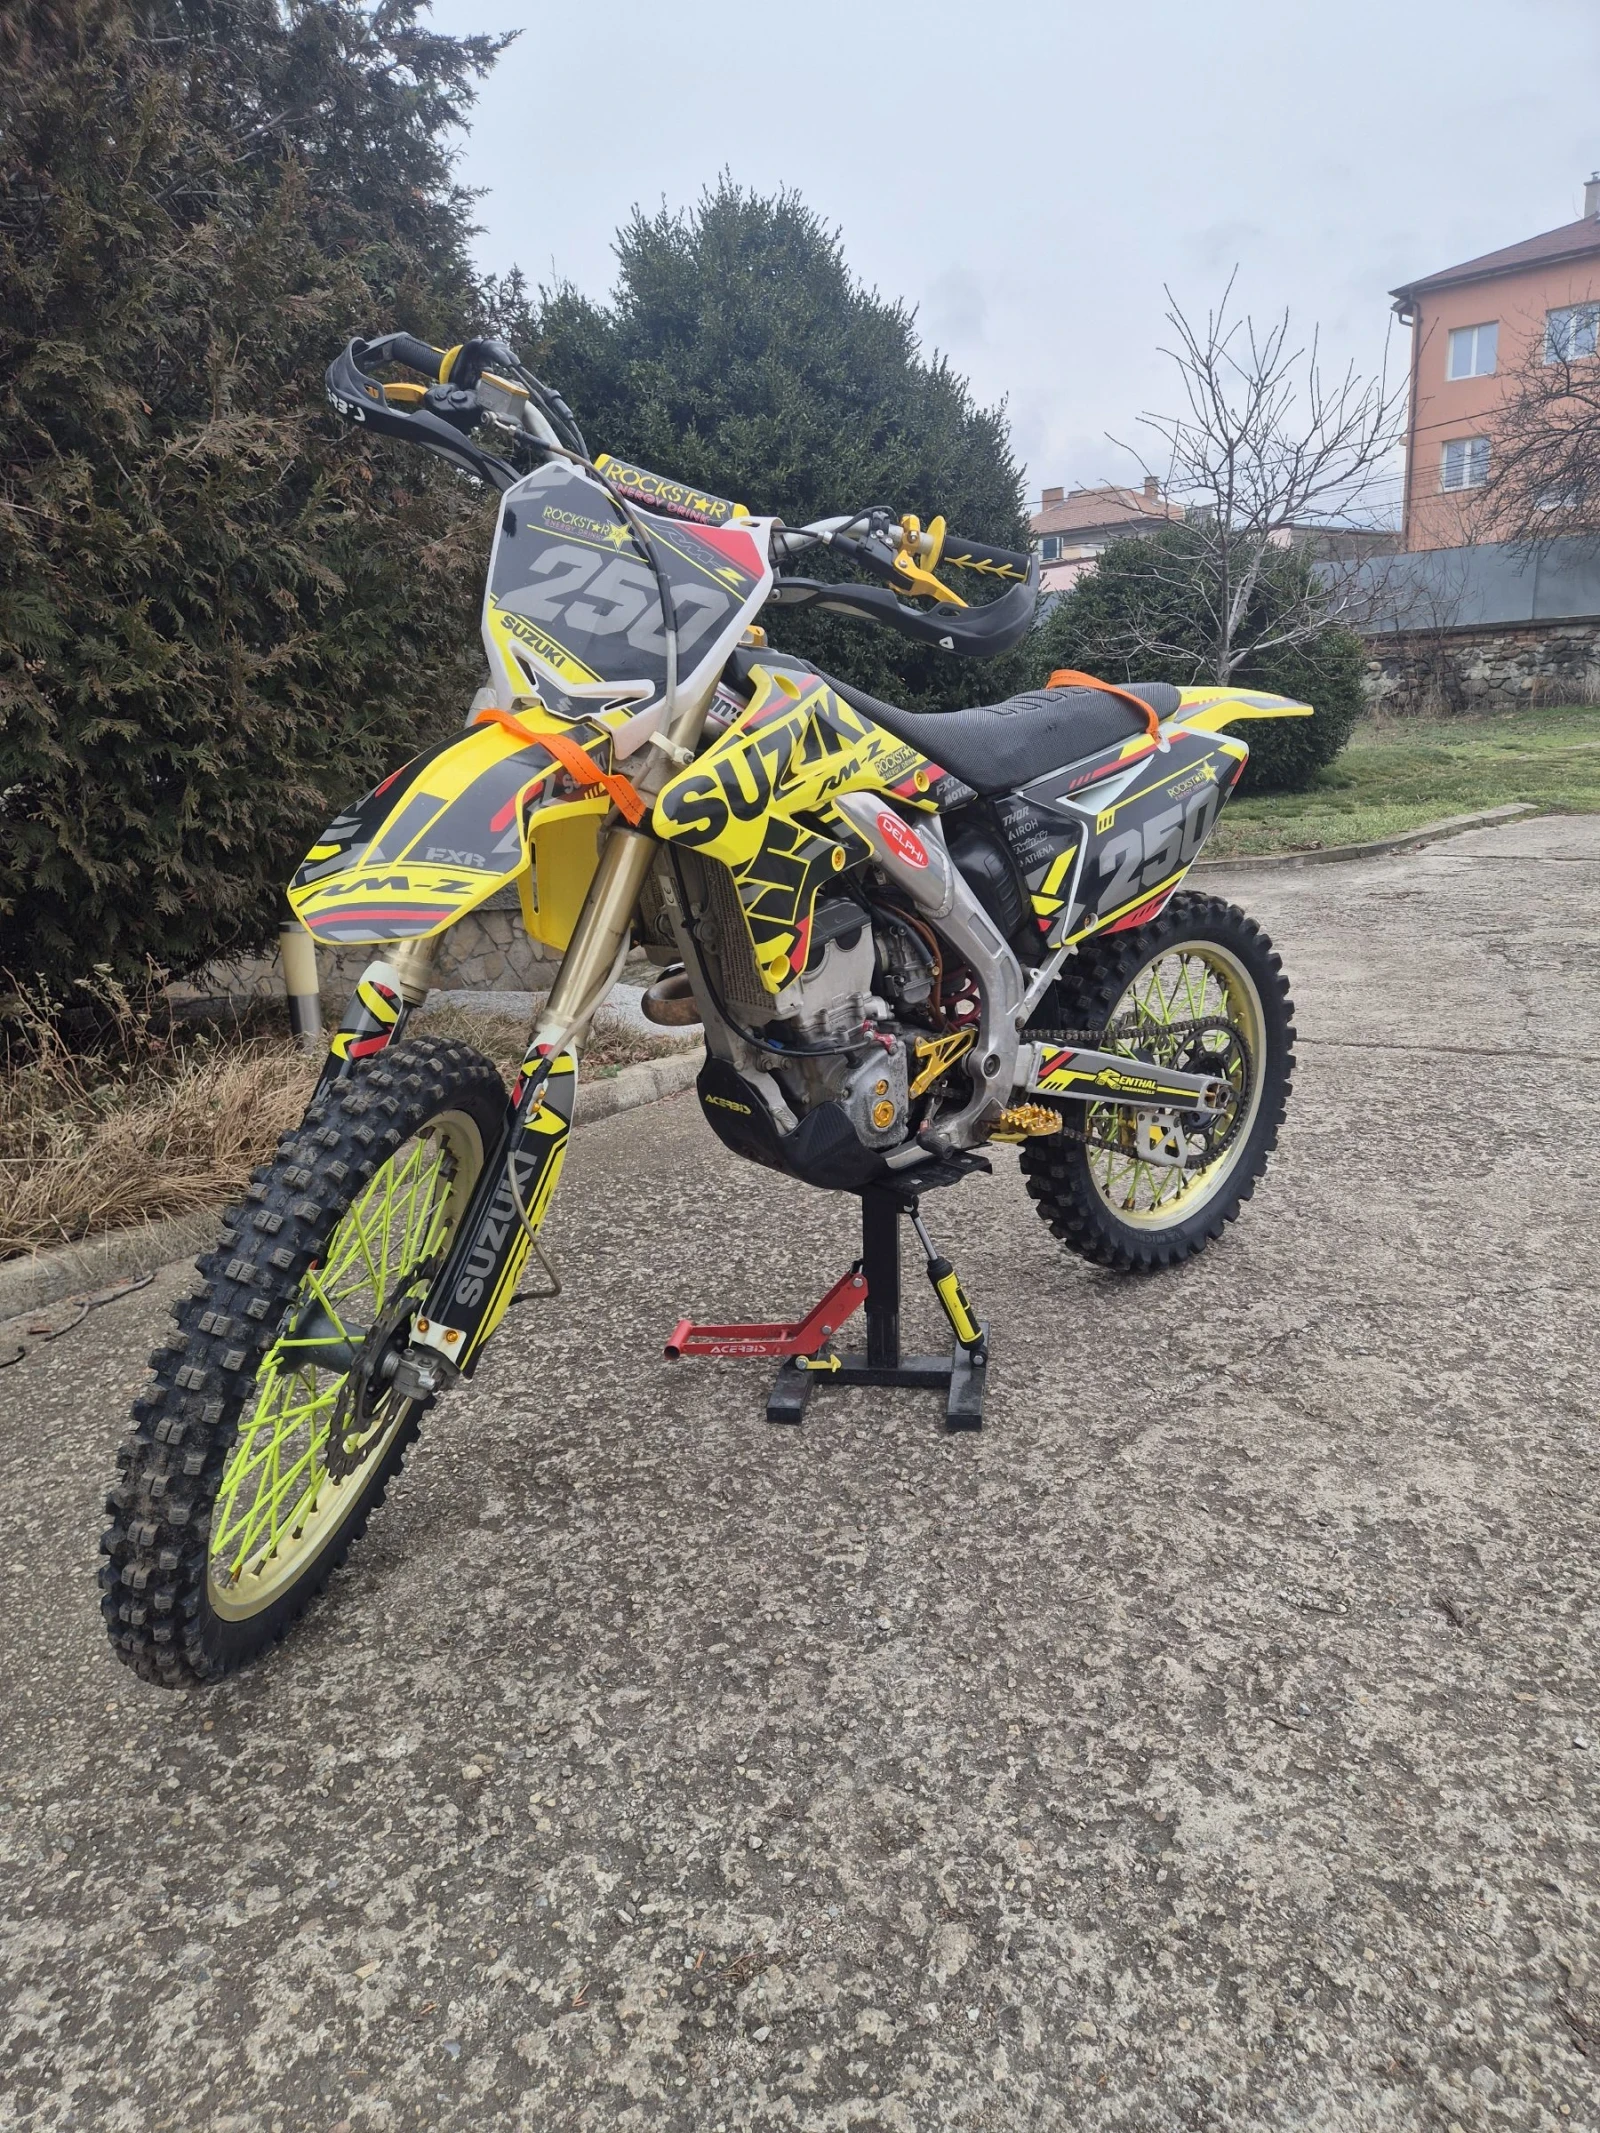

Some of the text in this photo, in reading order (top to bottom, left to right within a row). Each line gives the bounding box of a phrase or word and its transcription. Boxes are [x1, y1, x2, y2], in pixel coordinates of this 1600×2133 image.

[611, 481, 711, 526] ENERGY DRINK
[544, 519, 576, 533] ENERGY
[493, 545, 730, 658] 250
[500, 614, 567, 669] SUZUKI
[1002, 806, 1030, 827] THOR
[1008, 818, 1039, 841] AIROH
[425, 846, 486, 868] FXR
[883, 819, 923, 863] DELPHI
[1024, 844, 1055, 866] ATHENA
[1098, 784, 1219, 914] 250
[455, 1149, 538, 1309] SUZUKI
[710, 1344, 767, 1354] ACERBIS
